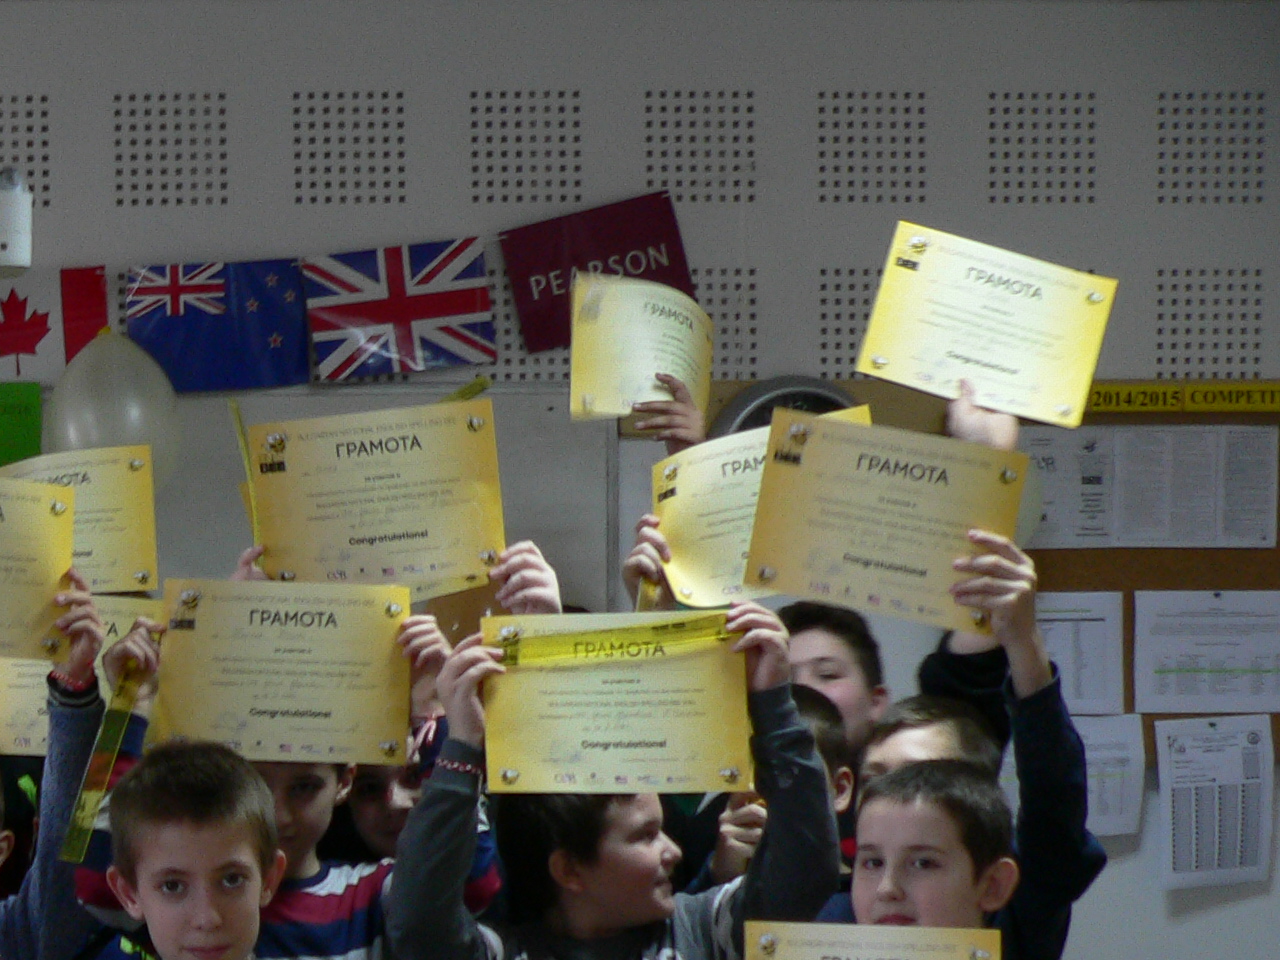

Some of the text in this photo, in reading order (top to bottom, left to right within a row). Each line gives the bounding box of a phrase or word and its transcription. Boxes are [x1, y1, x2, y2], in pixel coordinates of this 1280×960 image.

[966, 267, 1042, 299] ГРАМОТА
[1093, 390, 1181, 407] 2014/2015
[335, 435, 423, 458] ГРАМОТА
[721, 454, 767, 478] ГРАМ
[855, 453, 949, 485] ГРАМОТА
[249, 608, 338, 628] ГРАМОТА
[573, 641, 667, 658] ГРАМОТА
